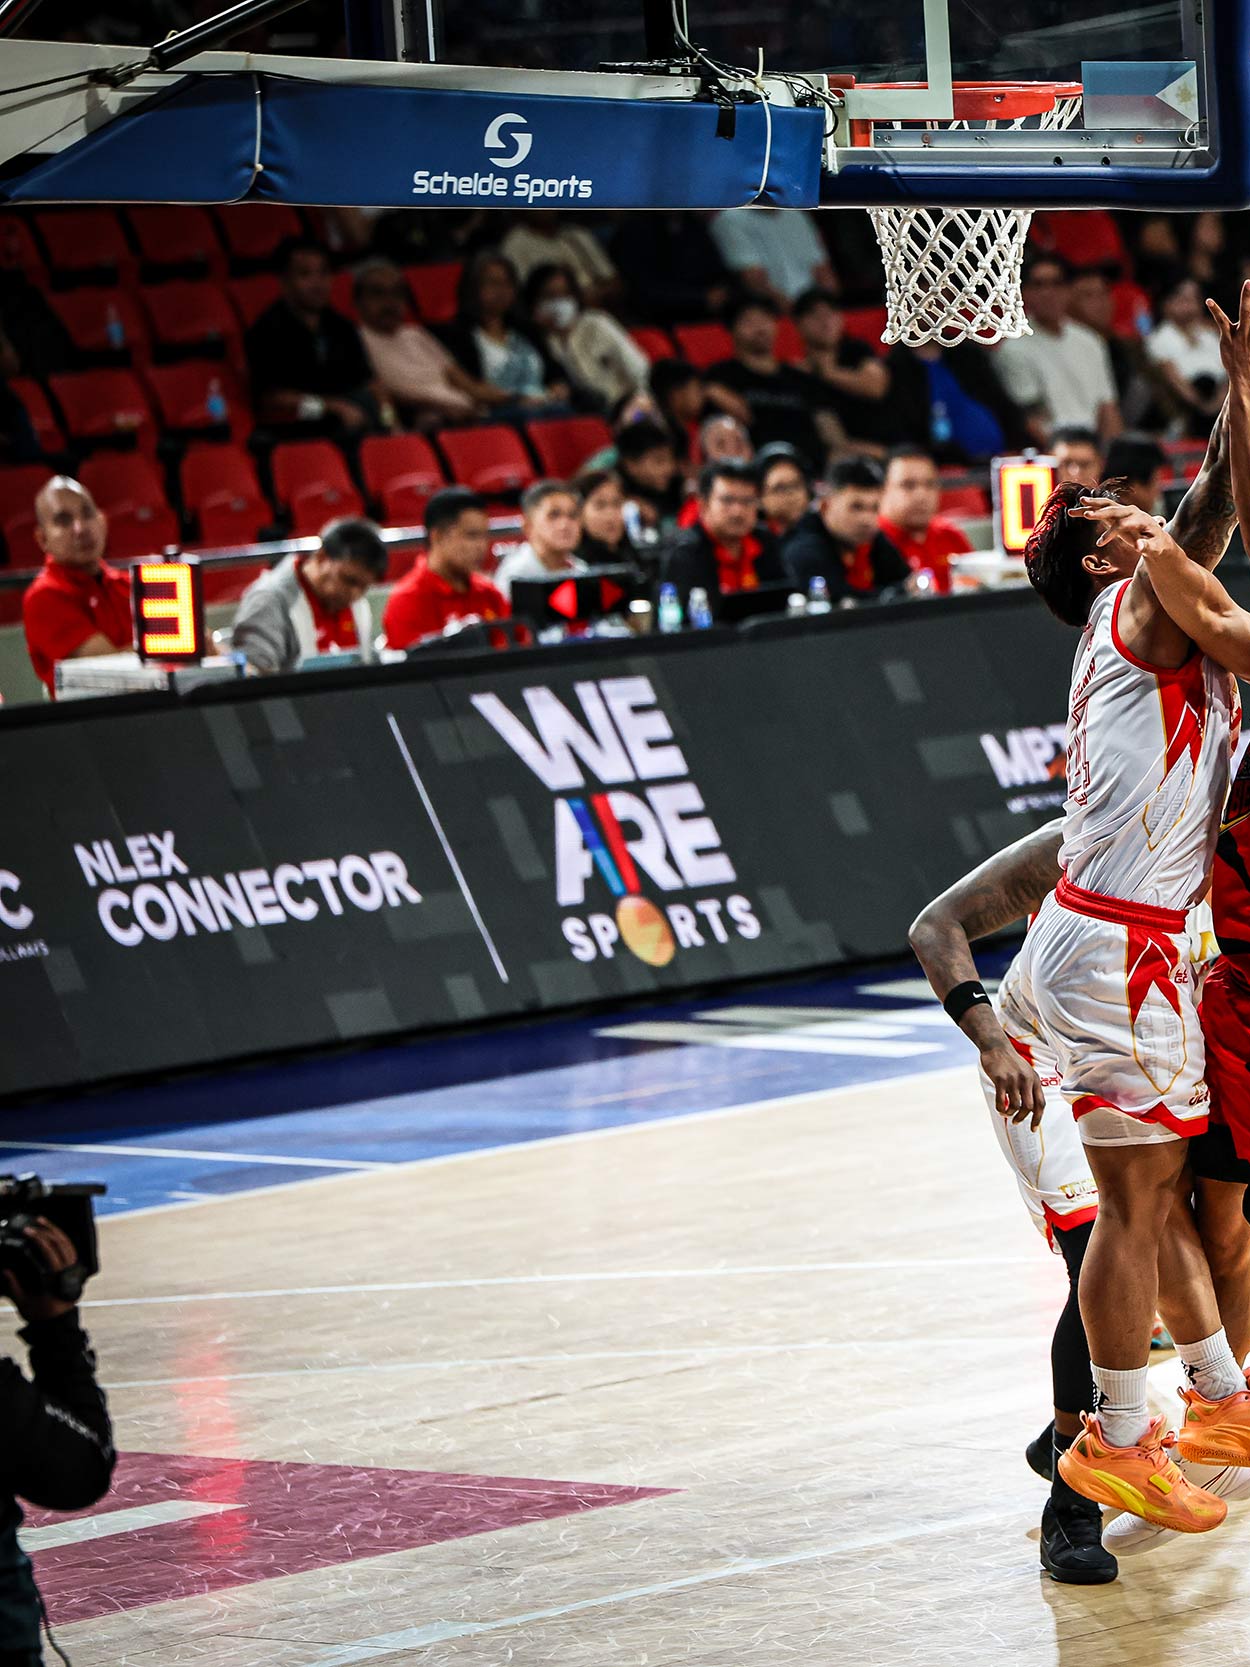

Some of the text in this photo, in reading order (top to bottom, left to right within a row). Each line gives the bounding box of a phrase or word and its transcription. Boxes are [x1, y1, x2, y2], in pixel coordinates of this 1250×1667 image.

[412, 170, 593, 204] Schelde Sports
[1000, 463, 1053, 551] 0
[140, 562, 196, 655] 3
[470, 676, 689, 791] WE
[73, 830, 189, 887] NLEX
[554, 781, 738, 907] ARE
[97, 851, 423, 947] CONNECTOR
[560, 894, 762, 968] SPORTS
